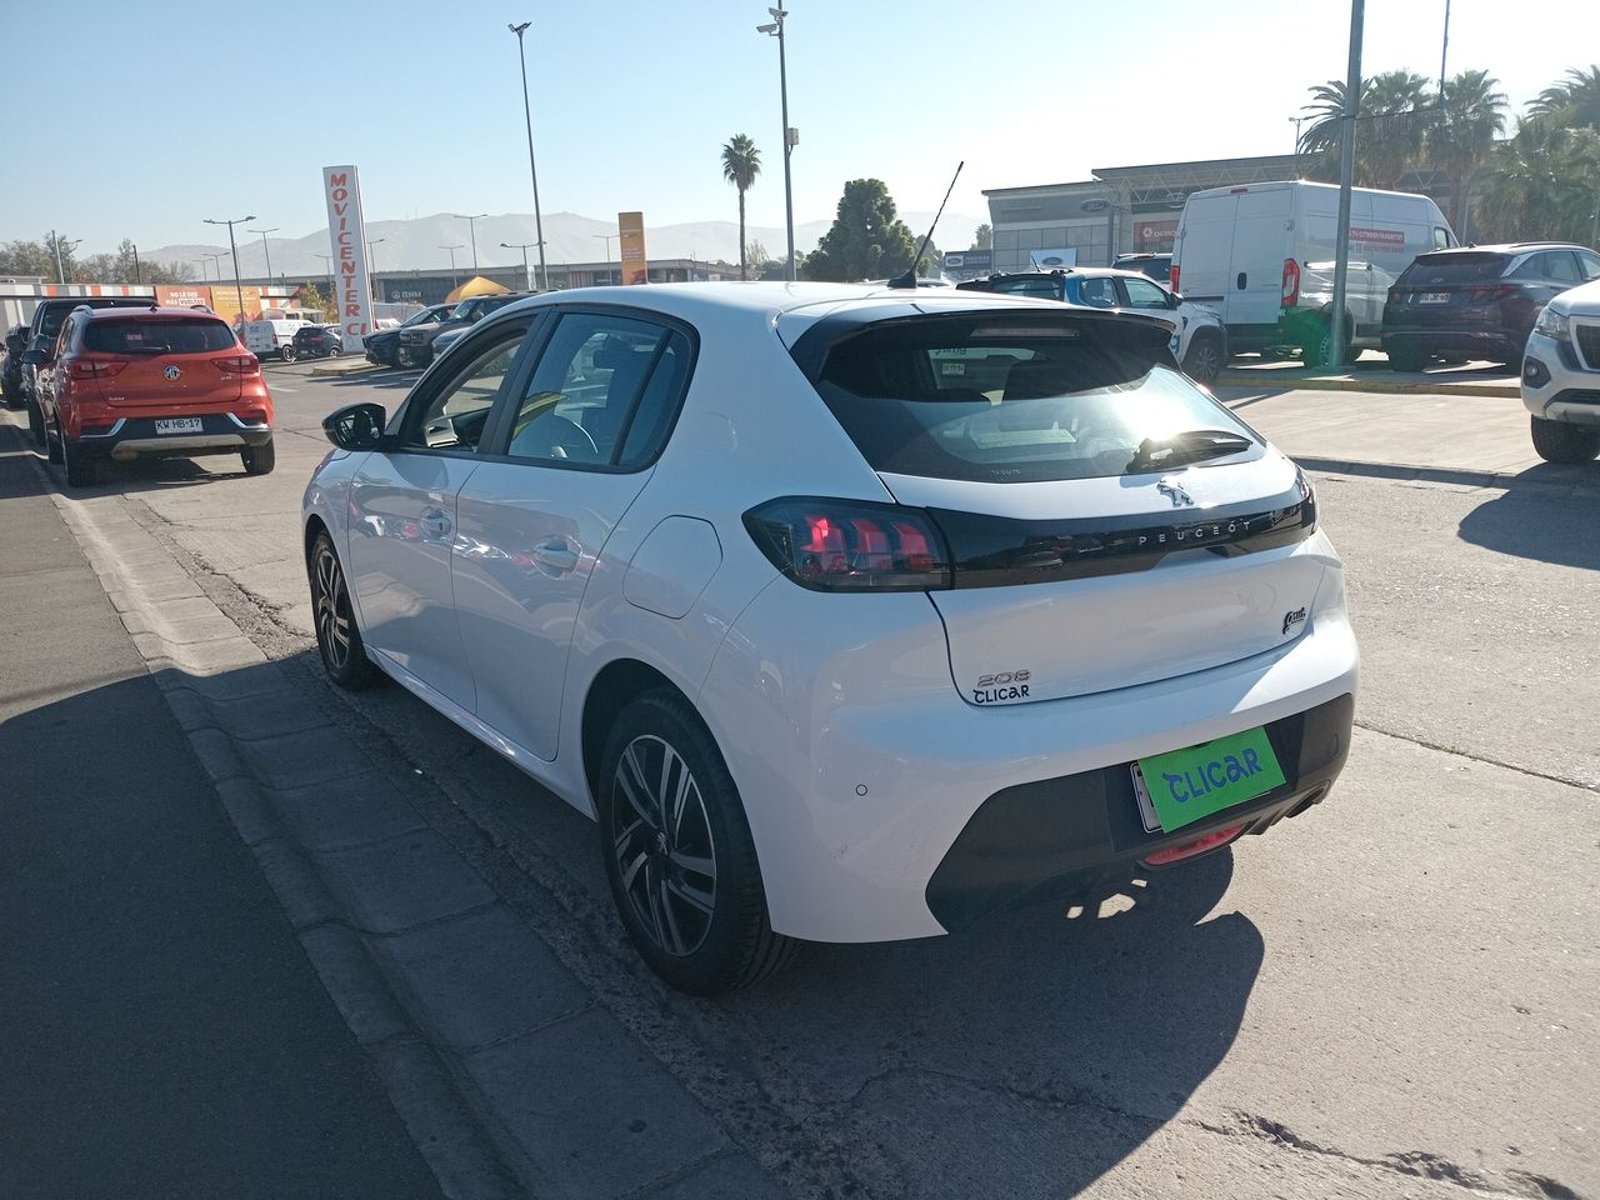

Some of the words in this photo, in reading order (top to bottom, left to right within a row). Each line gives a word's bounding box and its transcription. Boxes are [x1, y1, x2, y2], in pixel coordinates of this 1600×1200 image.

[330, 173, 361, 317] MOVICENTER
[1139, 521, 1250, 546] PEUGEOT
[976, 669, 1031, 687] 208
